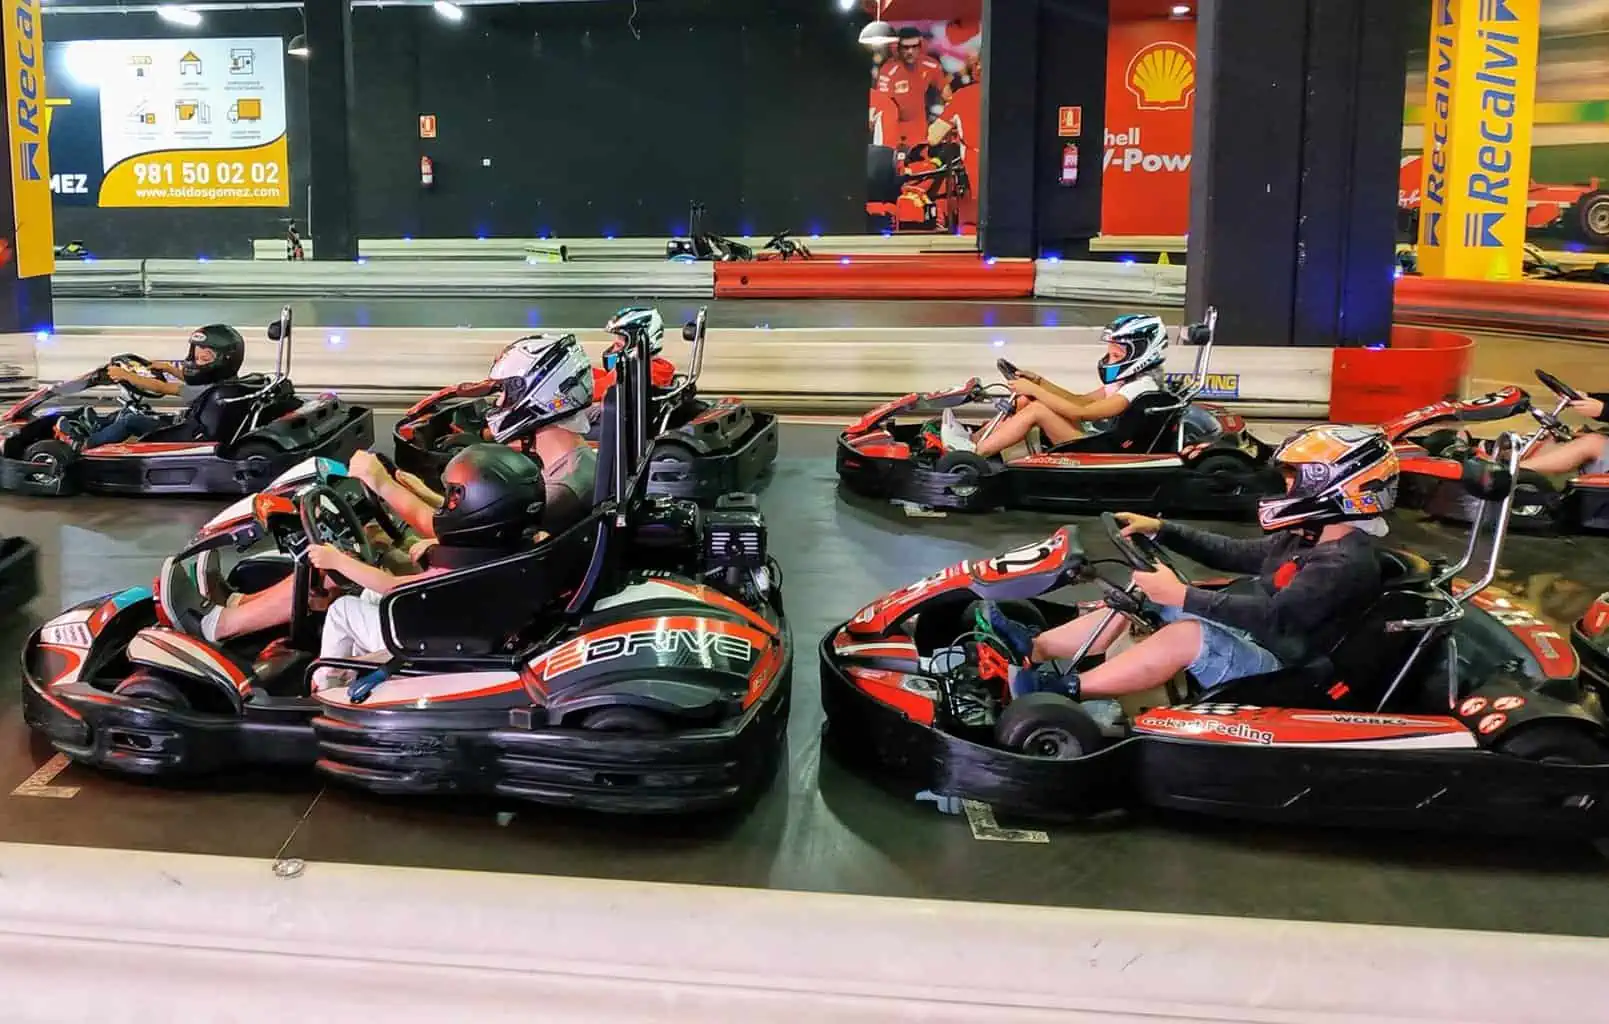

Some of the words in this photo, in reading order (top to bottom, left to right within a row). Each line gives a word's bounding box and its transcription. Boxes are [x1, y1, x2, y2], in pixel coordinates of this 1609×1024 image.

[1427, 35, 1453, 205] Recalvi
[1468, 29, 1519, 204] Recalvi
[1103, 127, 1140, 146] hell
[133, 162, 173, 184] 981
[183, 162, 210, 184] 50
[217, 162, 244, 184] 02
[251, 162, 280, 184] 02
[135, 186, 280, 200] www.toldosgomez.com
[1332, 714, 1407, 727] WORKS
[1205, 719, 1274, 745] Feeling
